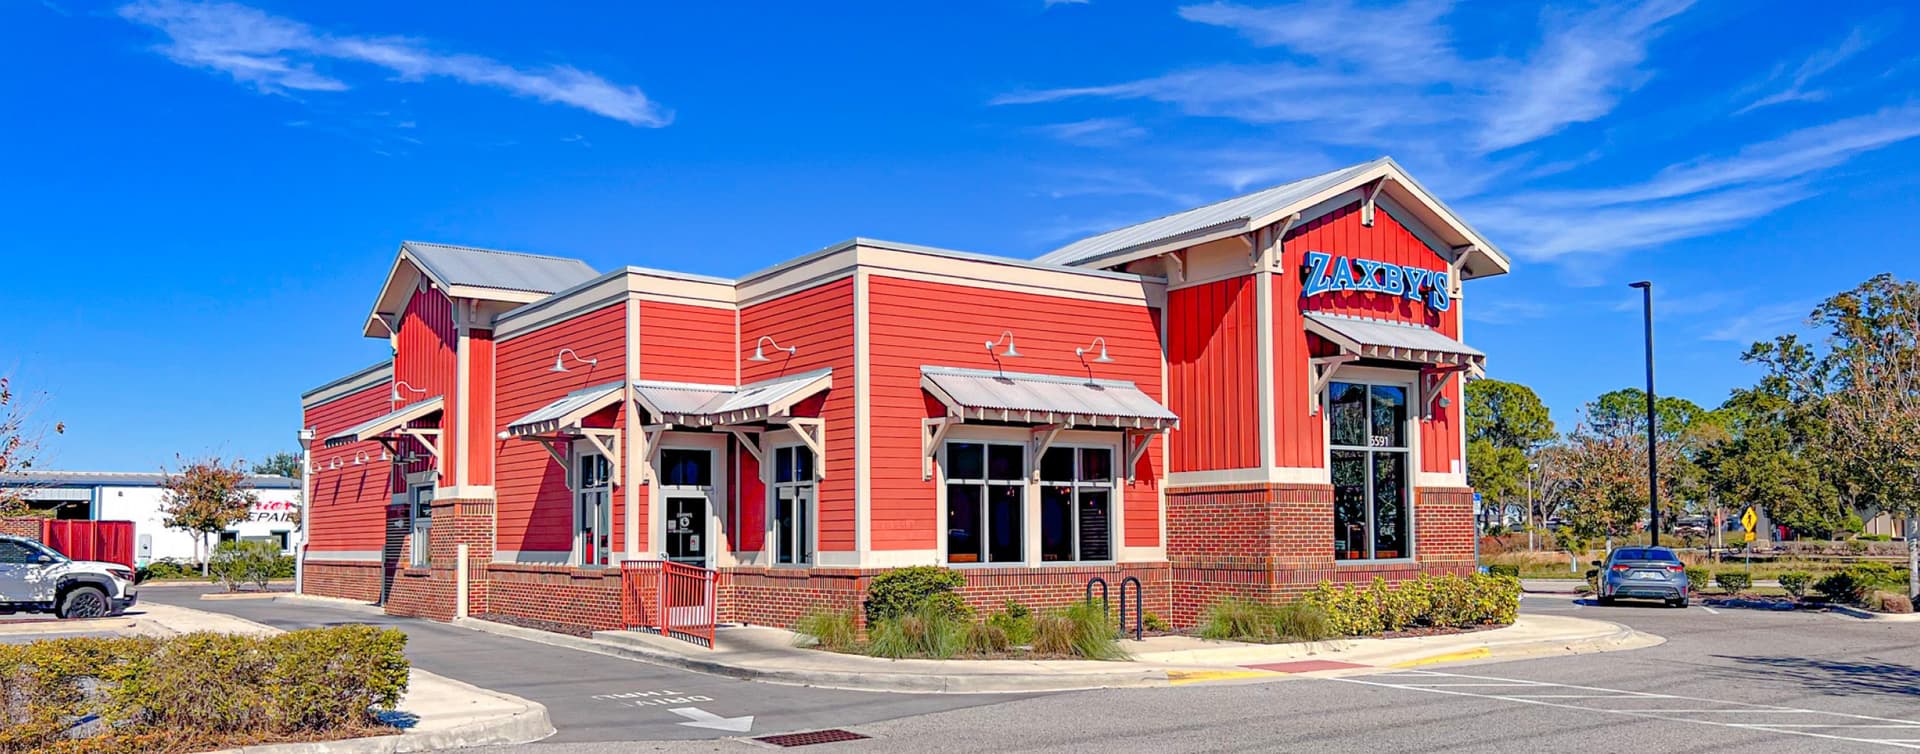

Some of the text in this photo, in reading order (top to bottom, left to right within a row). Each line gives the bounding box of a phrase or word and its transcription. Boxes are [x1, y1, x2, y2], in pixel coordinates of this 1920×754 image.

[1303, 251, 1450, 312] ZAXBY'S
[247, 512, 294, 522] EPAI
[621, 695, 714, 707] DRIV
